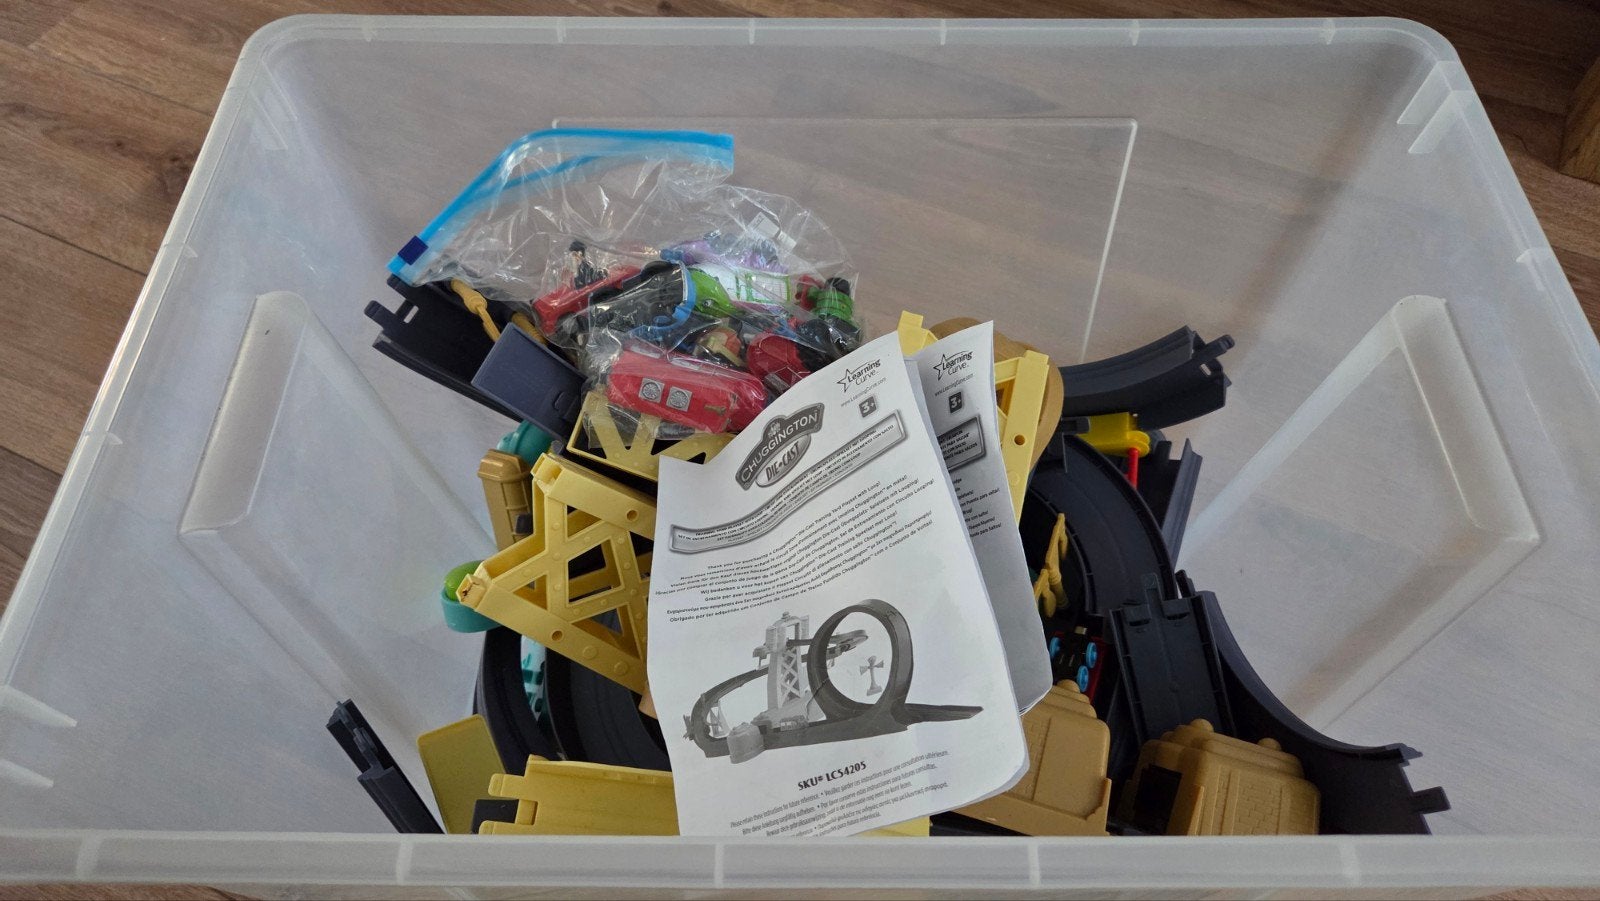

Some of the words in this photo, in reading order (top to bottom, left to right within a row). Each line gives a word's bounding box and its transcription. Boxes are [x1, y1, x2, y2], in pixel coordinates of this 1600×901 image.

[943, 351, 973, 370] Learning
[948, 362, 967, 375] Curve
[848, 359, 880, 382] Learning
[856, 370, 876, 385] Curve
[861, 401, 875, 413] 3+
[741, 412, 818, 482] CHUGGINGTON
[798, 775, 823, 791] SKU#
[826, 760, 867, 781] LC54205
